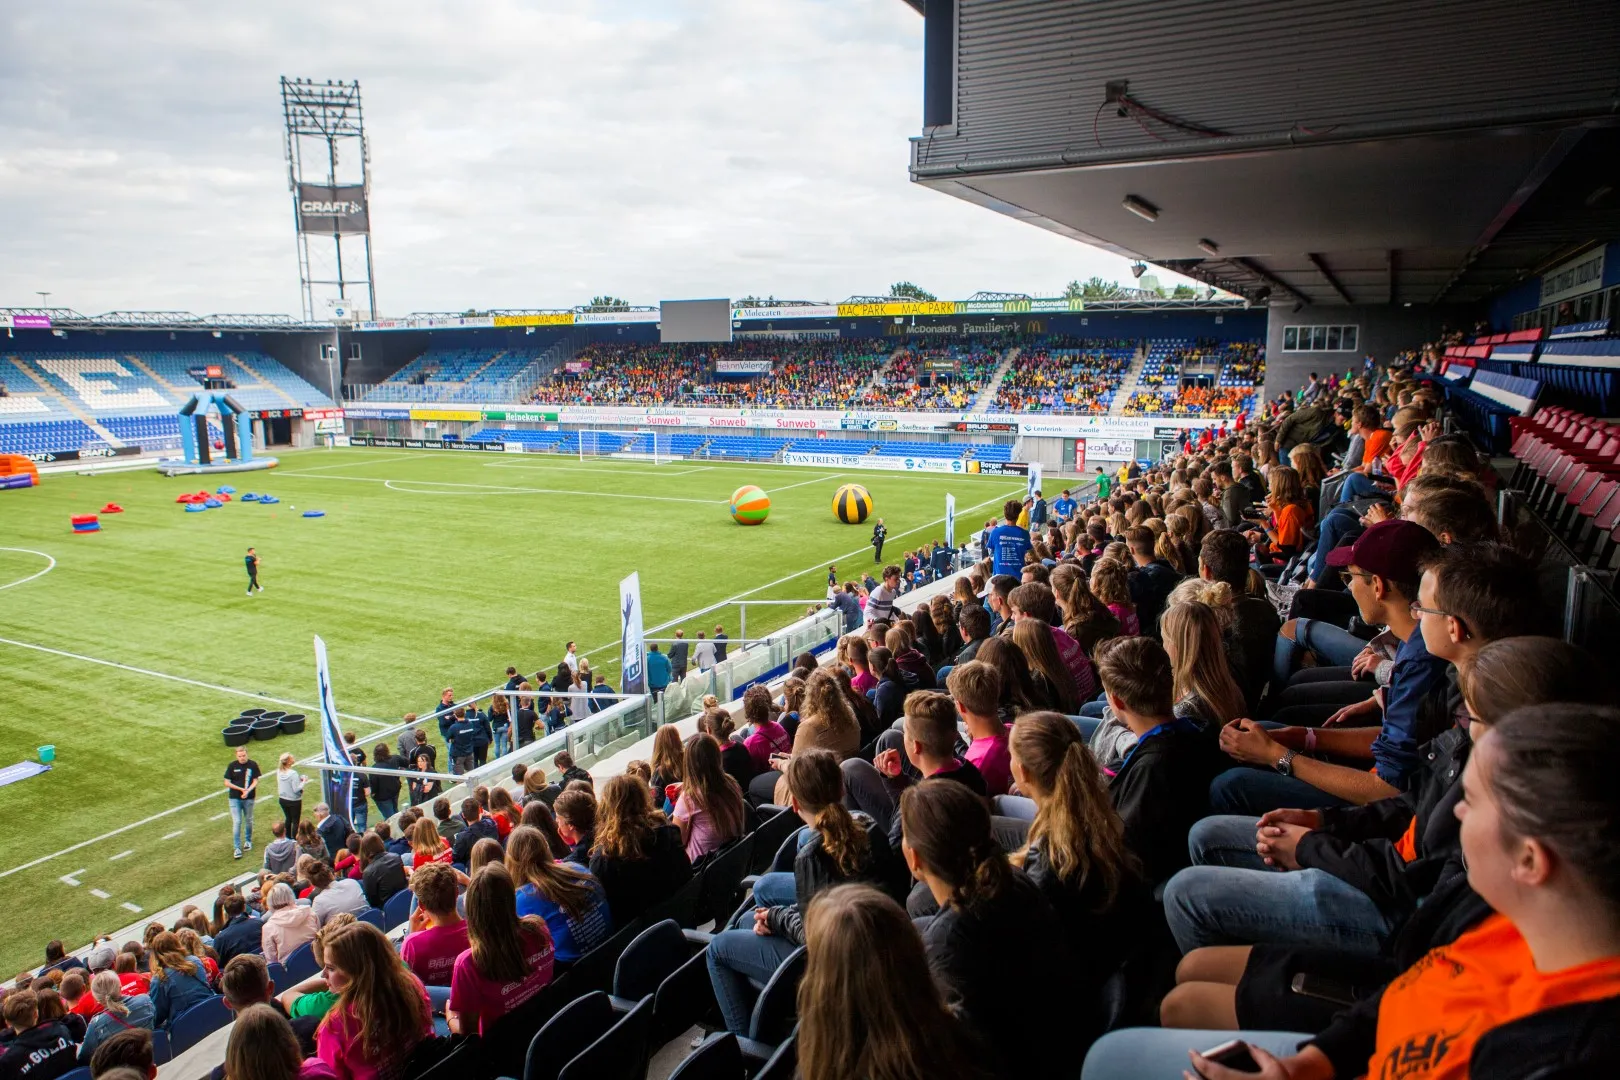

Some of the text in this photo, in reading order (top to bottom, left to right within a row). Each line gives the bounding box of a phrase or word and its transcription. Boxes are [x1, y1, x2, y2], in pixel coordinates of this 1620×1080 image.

[301, 201, 349, 213] CRAFT
[744, 309, 781, 317] Molecaten
[583, 314, 616, 322] Molecaten
[906, 325, 957, 334] McDonald's
[753, 332, 785, 341] DROST
[791, 331, 837, 341] TRIBUNE
[505, 412, 539, 422] Heineken
[750, 409, 784, 417] Molecaten
[856, 411, 893, 419] Molecaten
[647, 415, 681, 426] Sunweb
[709, 417, 746, 427] Sunweb
[973, 414, 1015, 422] Molecaten
[1102, 417, 1149, 427] Molecaten
[776, 419, 816, 429] Sunweb
[1033, 425, 1061, 433] Lenferink
[451, 442, 480, 450] Mercedes-Benz
[79, 448, 108, 458] CRAFT
[811, 456, 841, 464] TRIEST
[980, 461, 1002, 470] Borger
